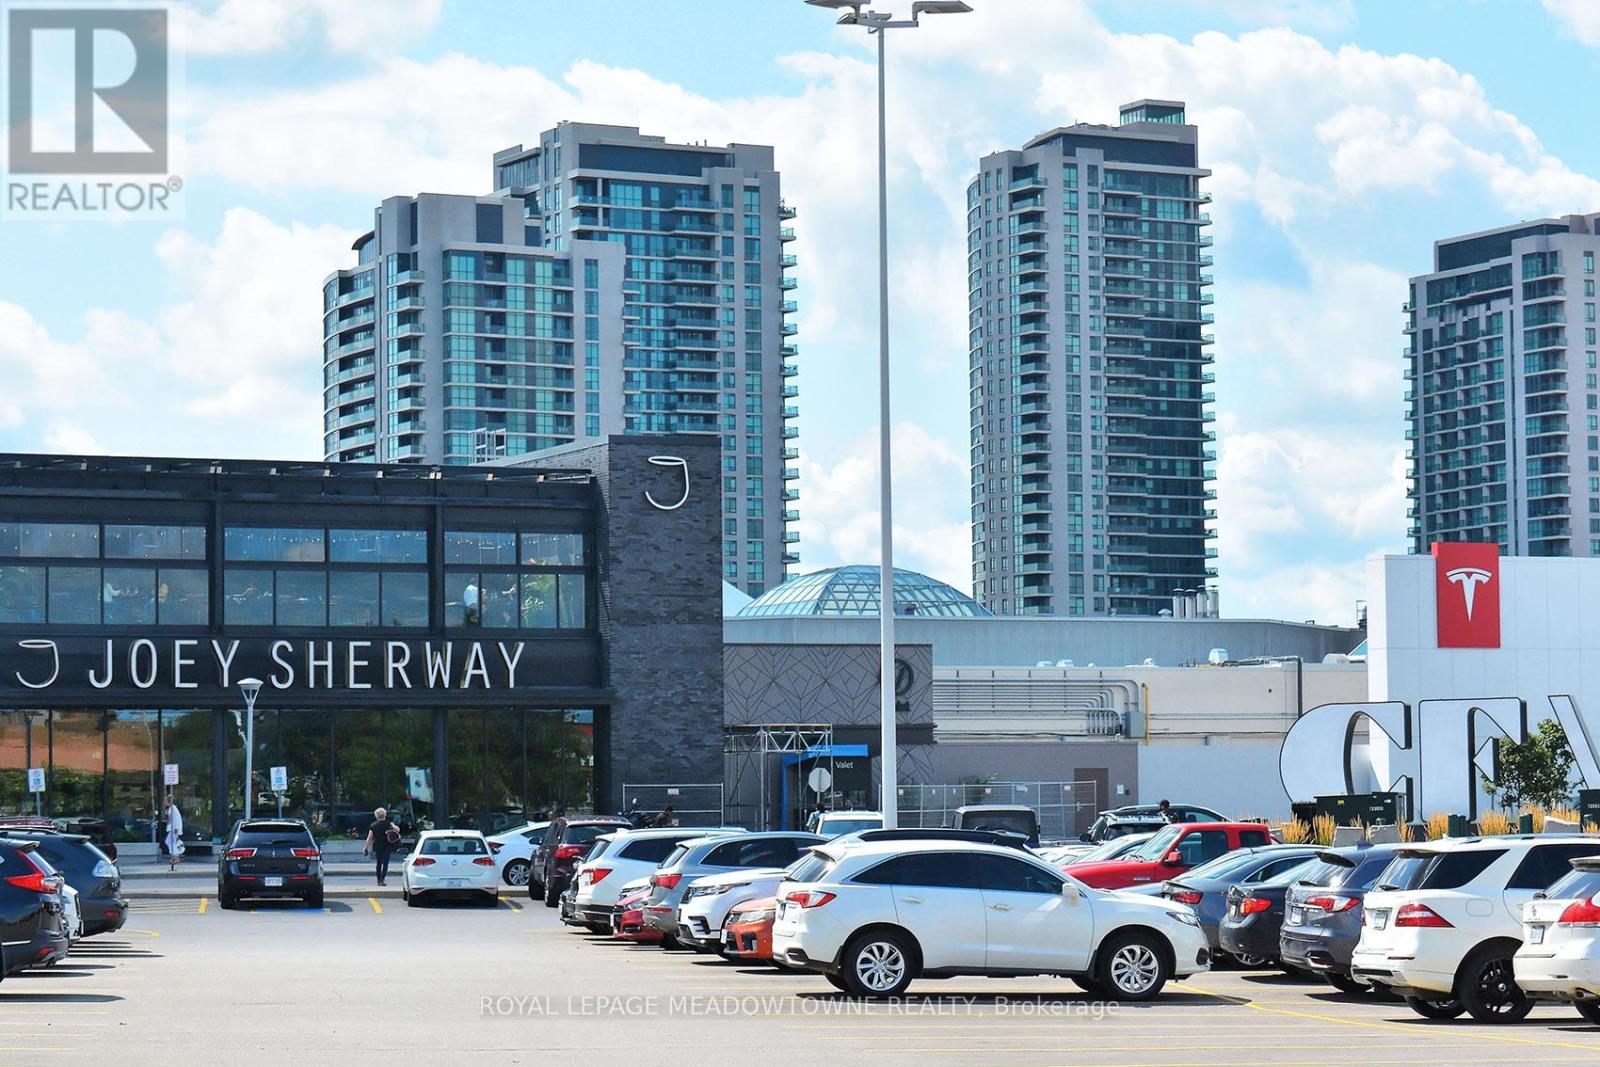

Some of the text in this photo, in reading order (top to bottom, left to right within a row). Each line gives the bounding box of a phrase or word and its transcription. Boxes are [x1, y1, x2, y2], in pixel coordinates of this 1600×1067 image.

[88, 639, 241, 688] JOEY
[270, 640, 525, 689] SHERWAY
[835, 761, 854, 769] Valet
